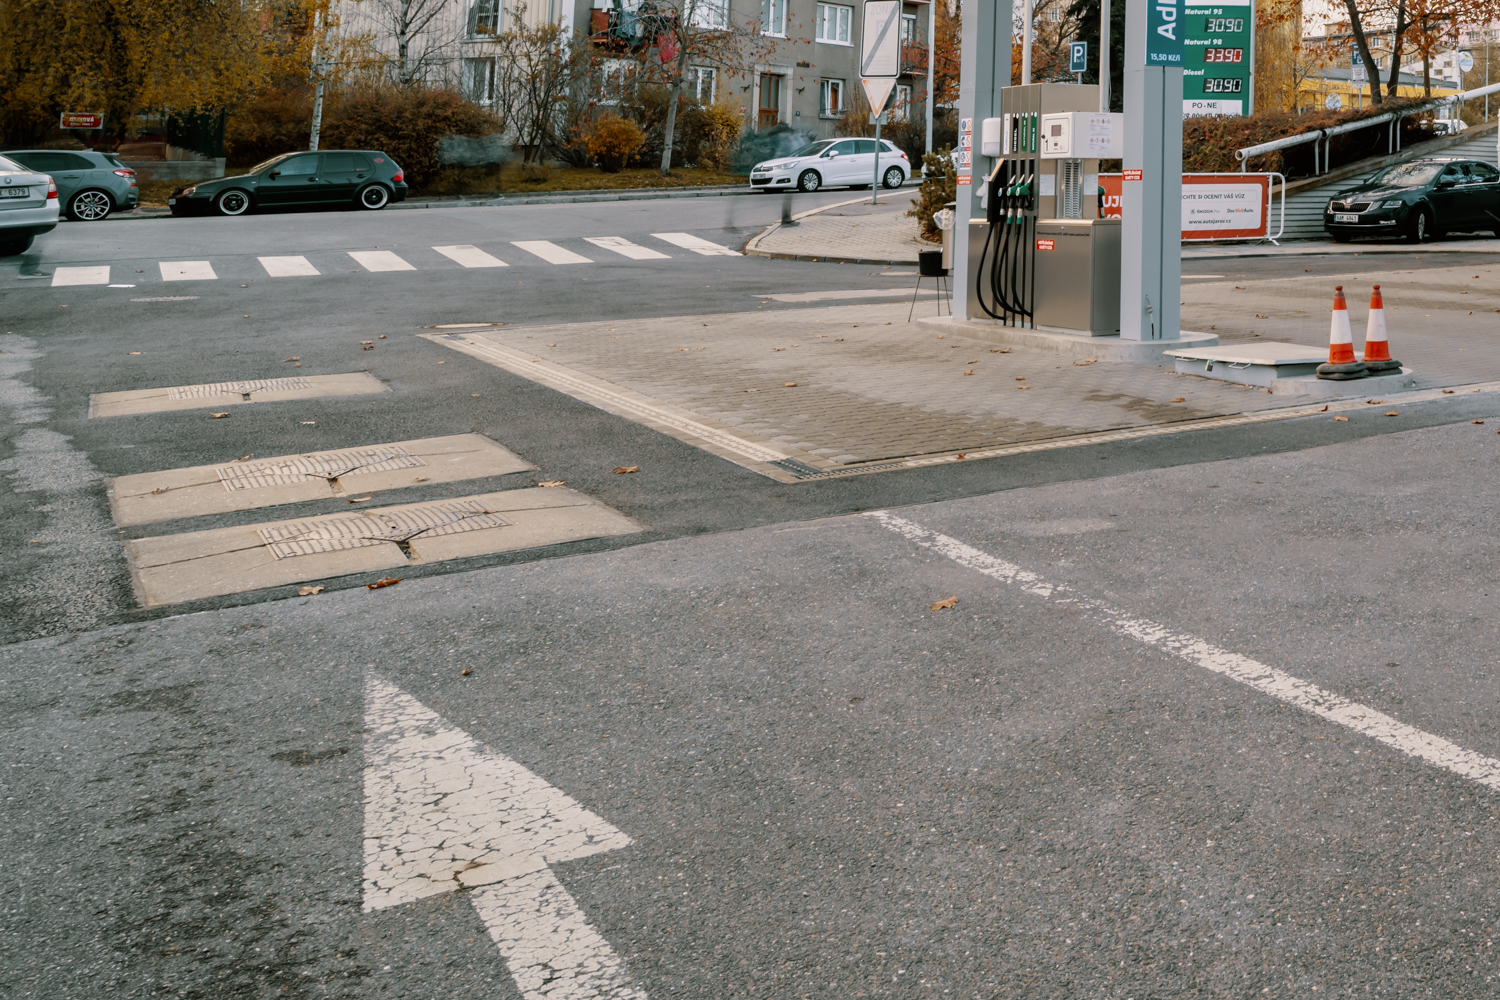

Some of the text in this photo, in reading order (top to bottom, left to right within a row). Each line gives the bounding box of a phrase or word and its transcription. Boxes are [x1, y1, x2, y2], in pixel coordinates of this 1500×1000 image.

[1207, 18, 1243, 32] 30.90
[1073, 45, 1083, 63] P
[1150, 53, 1167, 61] 15,50
[1206, 48, 1243, 62] 33.90
[1205, 79, 1242, 93] 30.90
[1102, 195, 1122, 208] UJ
